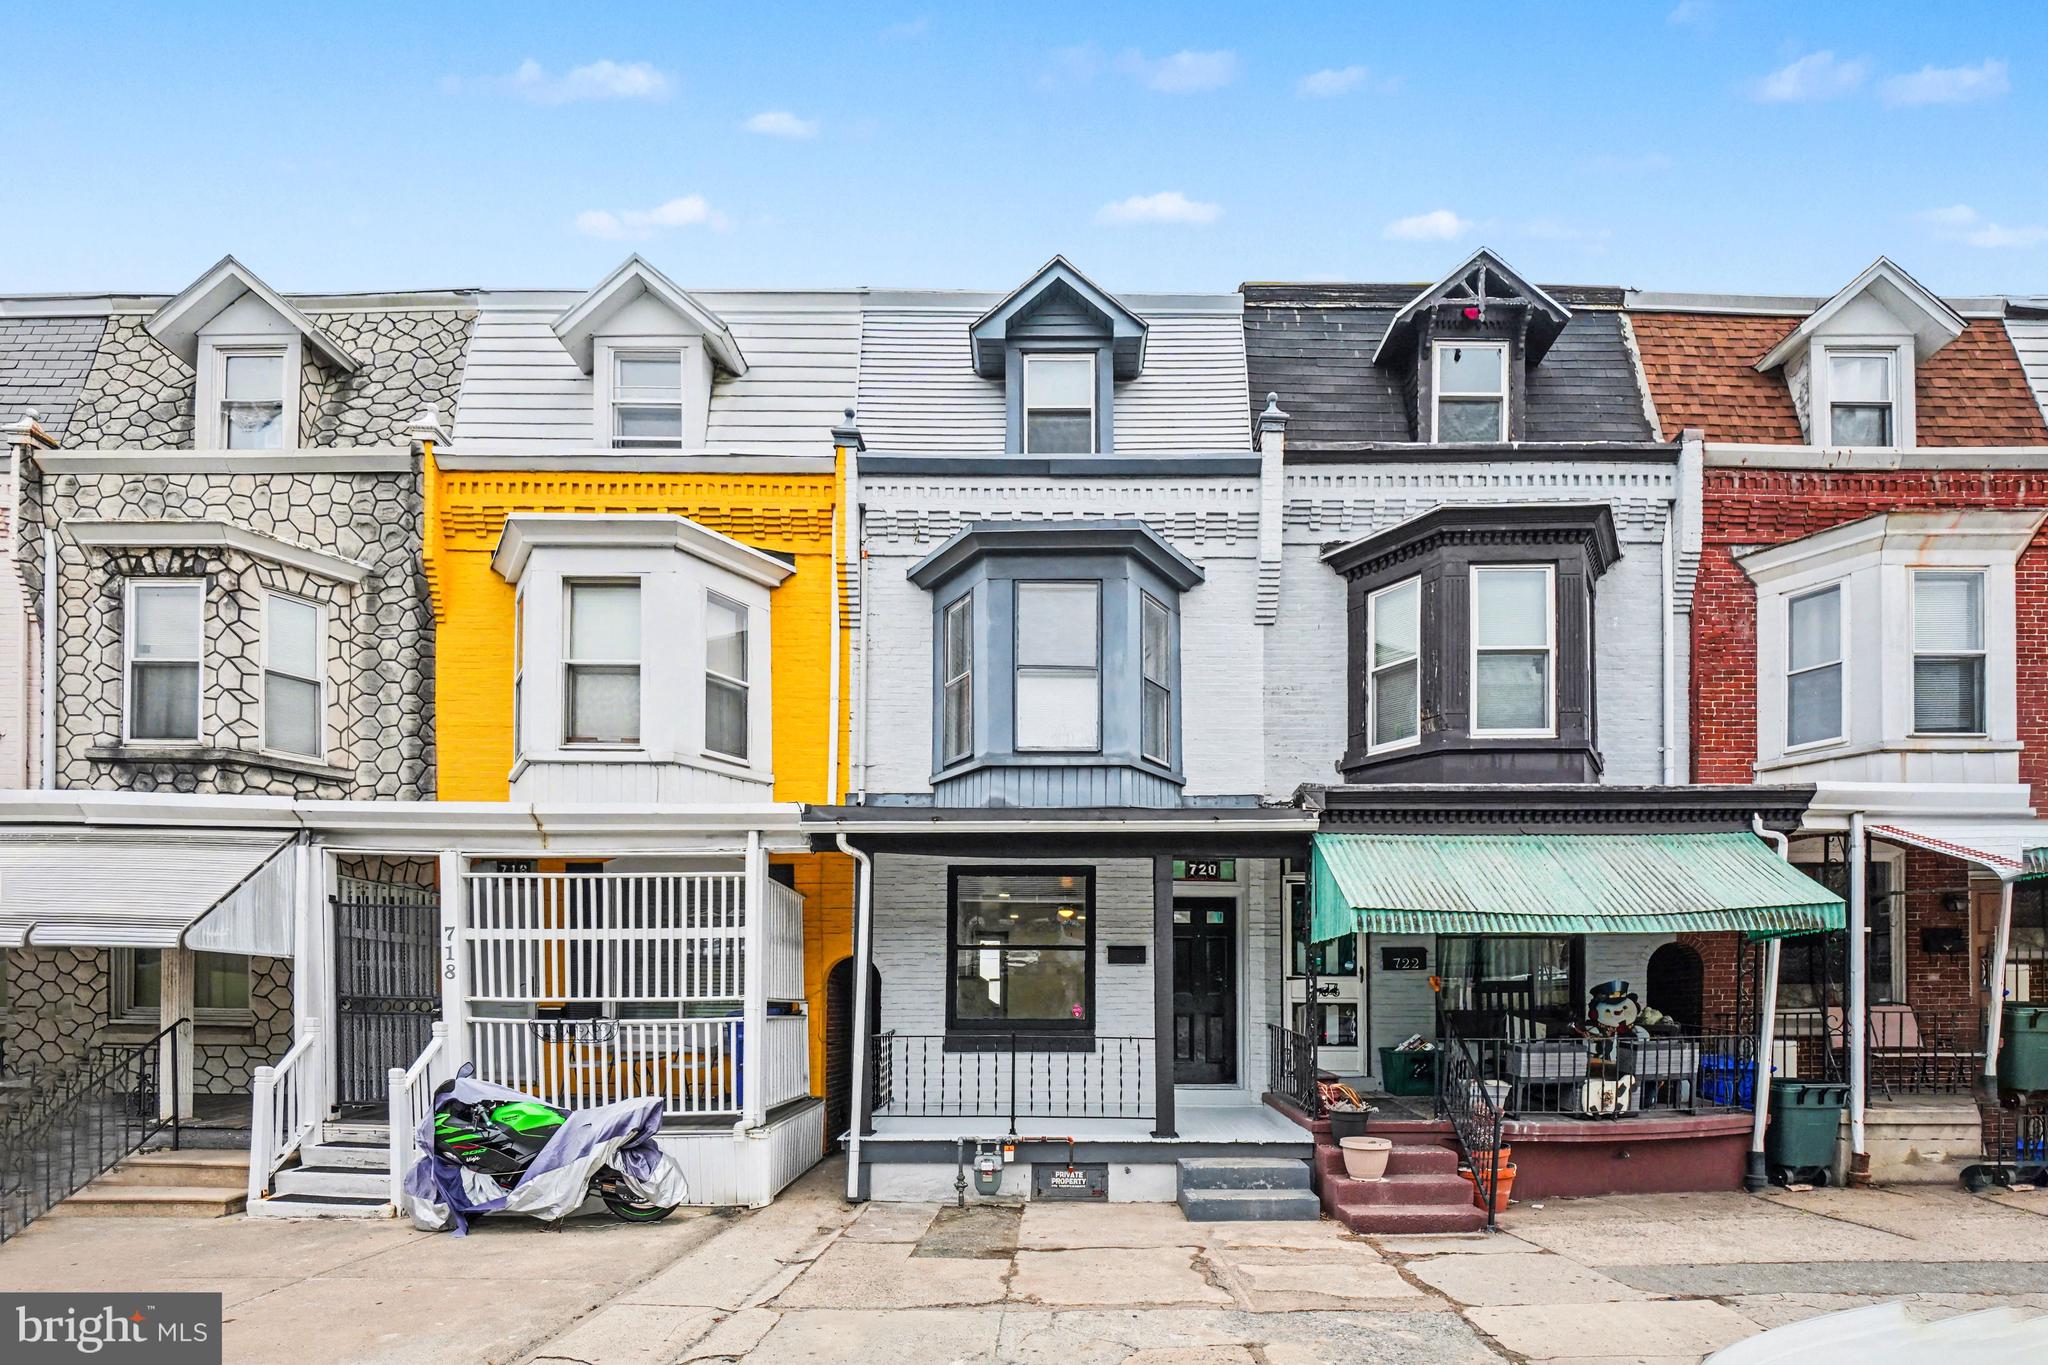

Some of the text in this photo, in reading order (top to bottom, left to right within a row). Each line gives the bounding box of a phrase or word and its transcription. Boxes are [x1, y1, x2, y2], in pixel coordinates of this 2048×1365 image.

[1189, 864, 1216, 875] 720
[444, 926, 456, 980] 718
[1392, 957, 1419, 969] 722
